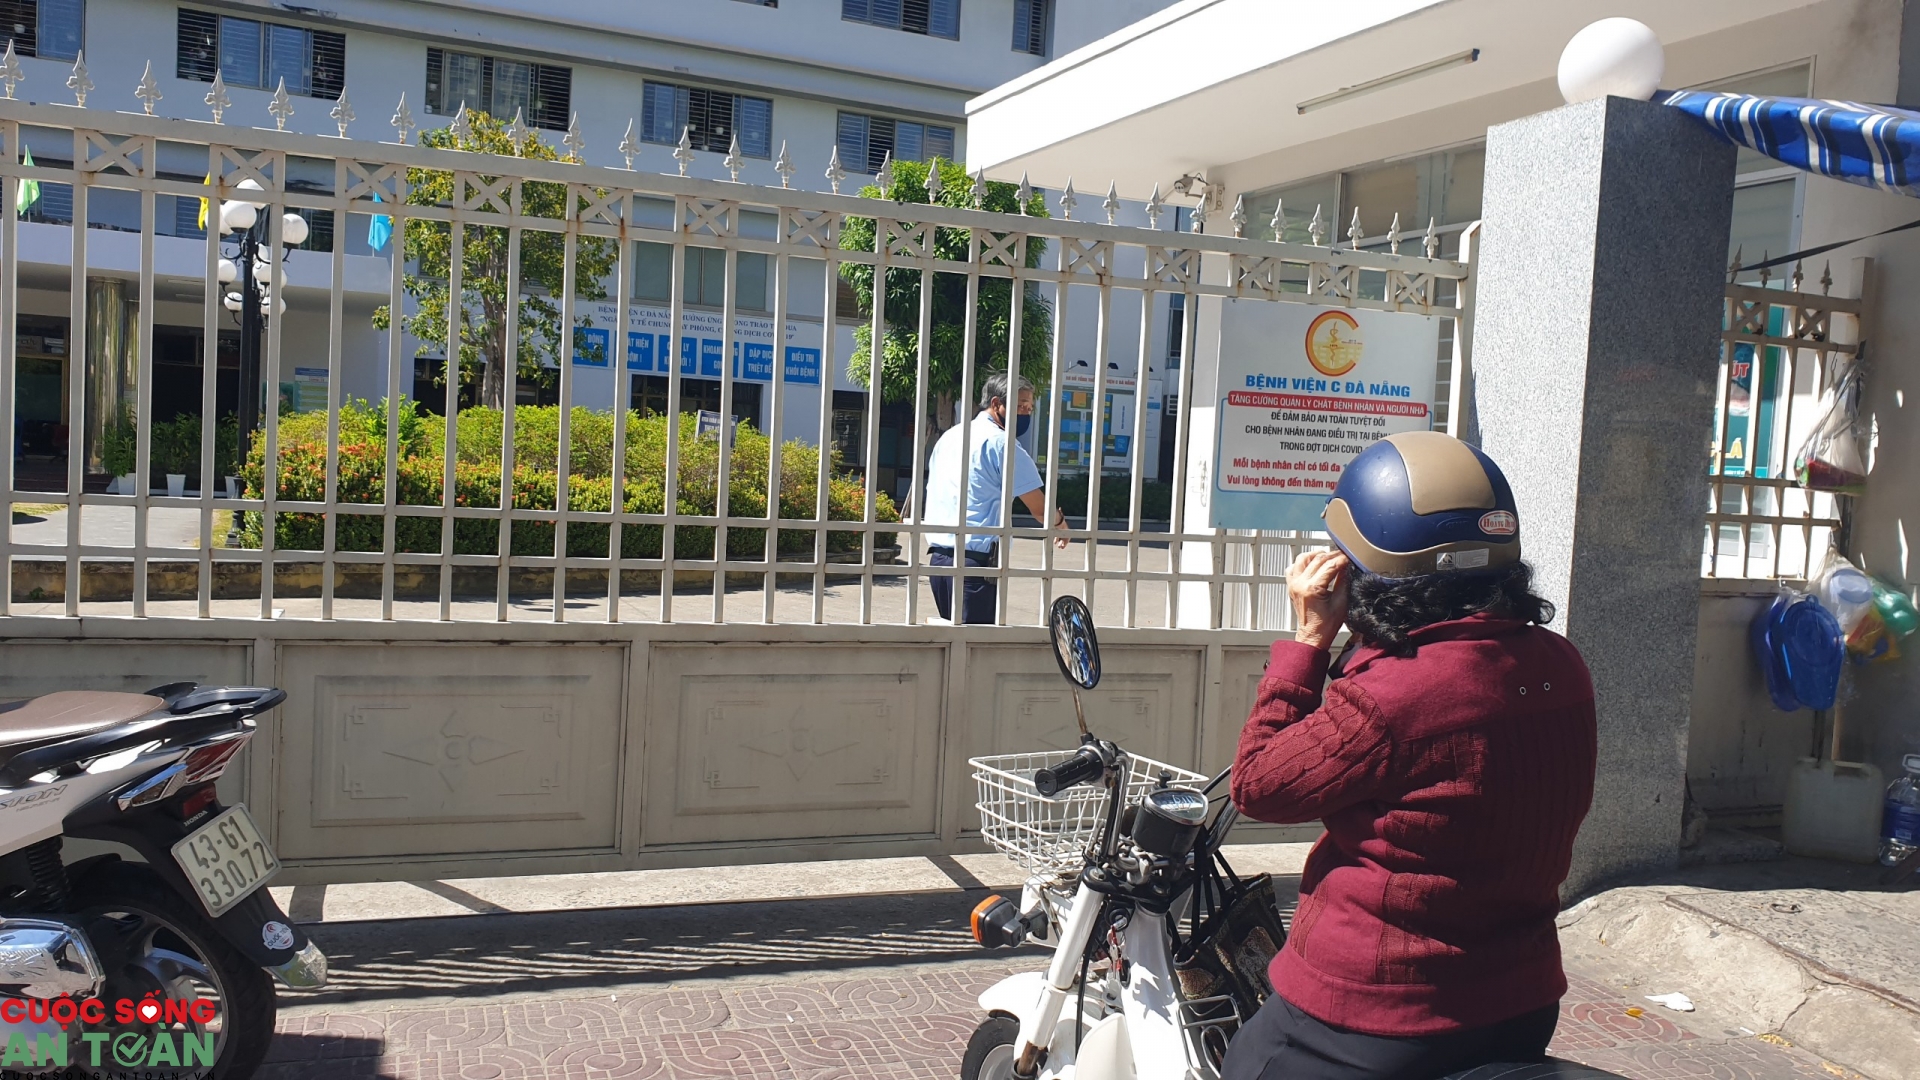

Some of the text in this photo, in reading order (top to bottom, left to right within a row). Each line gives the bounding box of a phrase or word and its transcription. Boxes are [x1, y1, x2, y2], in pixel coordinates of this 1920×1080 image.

[1245, 373, 1411, 397] BỆNH VIỆN C ĐÀ NẴNG
[1230, 394, 1425, 415] TĂNG CƯỜNG QUẢN LÝ CHẶT BỆNH NHÂN VÀ NGƯỜI NHÀ
[1271, 408, 1386, 427] ĐỂ ĐẢM BẢO AN TOÀN TUYỆT ĐỐI
[1245, 425, 1261, 435] CHO
[1262, 424, 1283, 436] BỆNH
[1284, 426, 1305, 437] NHÂN
[1306, 428, 1327, 438] ĐANG
[1328, 427, 1345, 439] ĐIỀU
[1346, 430, 1358, 441] TRỊ
[1359, 431, 1370, 442] TẠI
[1280, 442, 1305, 452] TRONG
[1306, 443, 1321, 454] ĐỢT
[1322, 444, 1340, 455] DỊCH
[1233, 457, 1249, 468] Mỗi
[1250, 459, 1270, 471] bệnh
[1272, 460, 1292, 471] nhân
[1294, 460, 1306, 471] chỉ
[1307, 461, 1317, 471] có
[1319, 461, 1329, 472] tối
[1330, 462, 1341, 473] đa
[1227, 474, 1241, 485] Vui
[1242, 476, 1259, 487] lòng
[1261, 476, 1286, 488] không
[1287, 477, 1302, 487] đến
[1304, 478, 1324, 488] thăm
[183, 810, 208, 827] HONDA
[189, 815, 248, 870] 43-G1
[201, 841, 274, 907] 330.72
